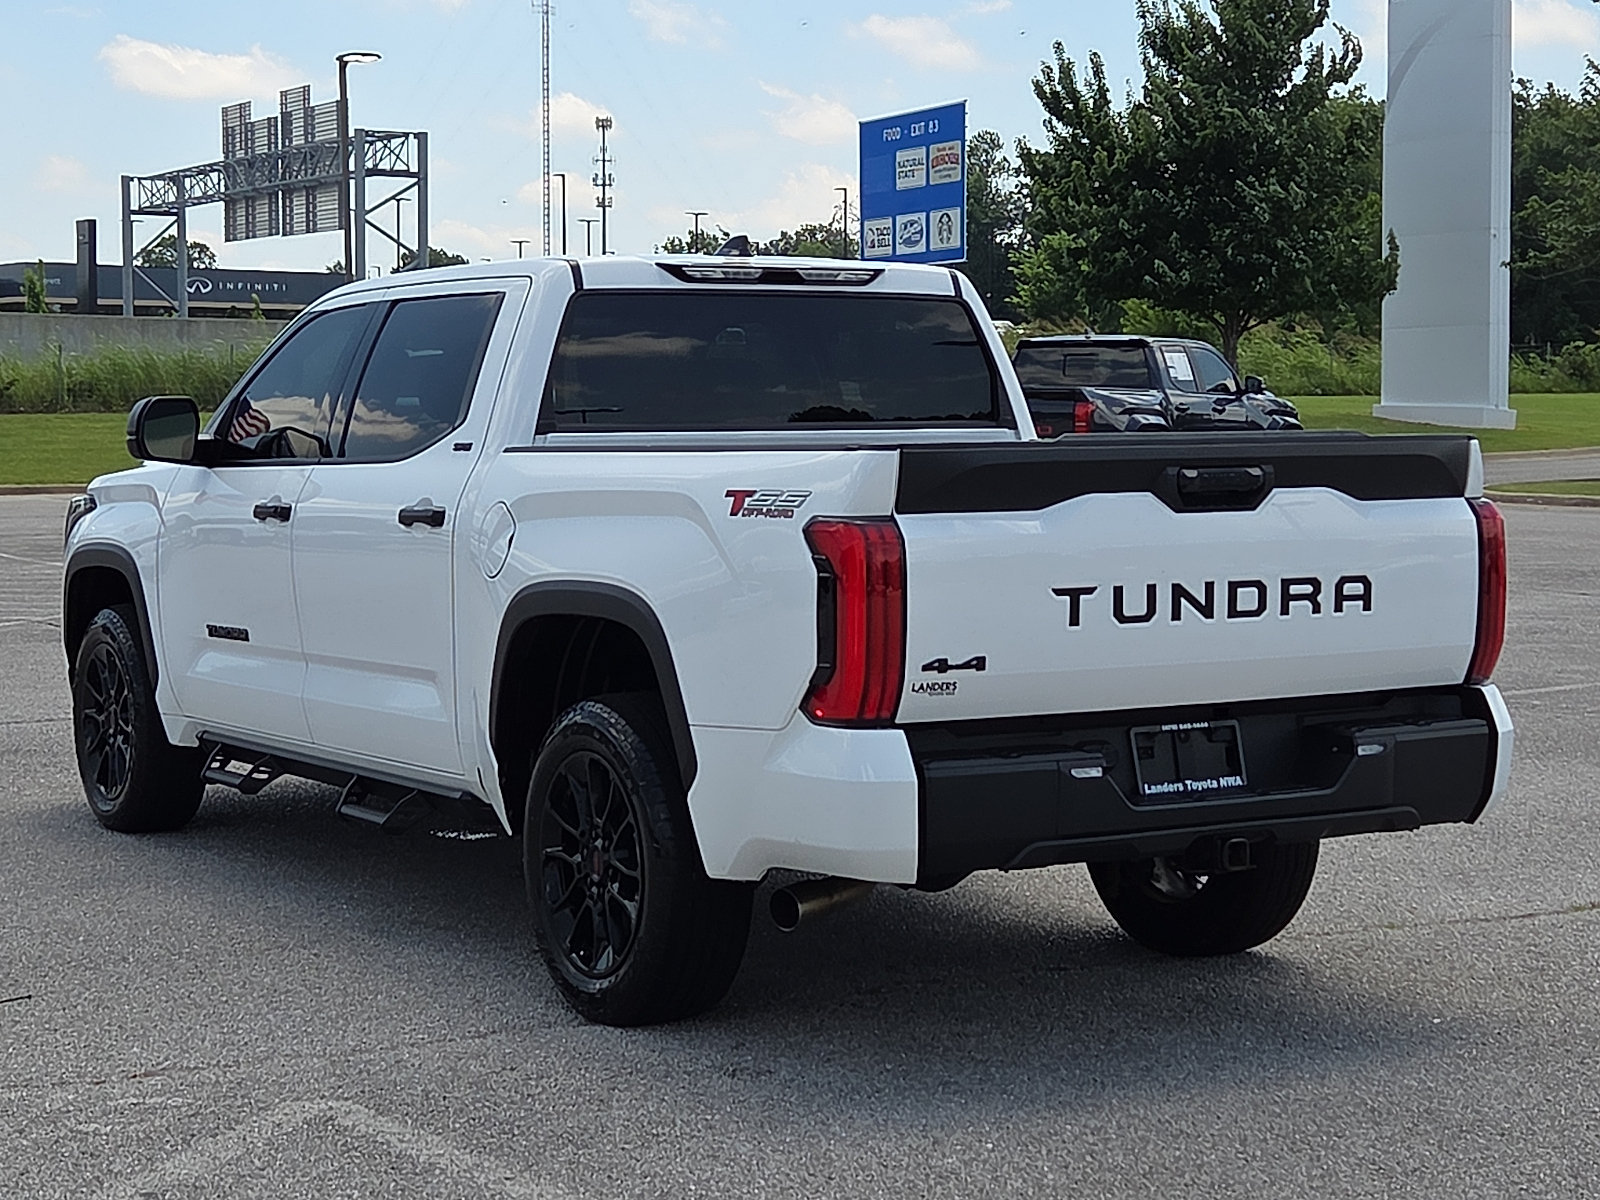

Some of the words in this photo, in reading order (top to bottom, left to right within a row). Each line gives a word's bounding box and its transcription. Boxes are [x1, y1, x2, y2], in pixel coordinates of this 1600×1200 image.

[883, 127, 901, 142] FOOD
[911, 122, 925, 137] EXIT
[898, 157, 925, 169] NATURAL
[898, 169, 916, 180] STATE
[876, 226, 891, 237] TACO
[877, 238, 891, 248] BELL
[218, 281, 287, 292] INFINITI
[1050, 574, 1373, 628] TUNDRA
[911, 681, 958, 694] LANDERS
[1144, 782, 1184, 794] Landers
[1185, 778, 1218, 791] Toyota
[1219, 776, 1242, 787] NWA
